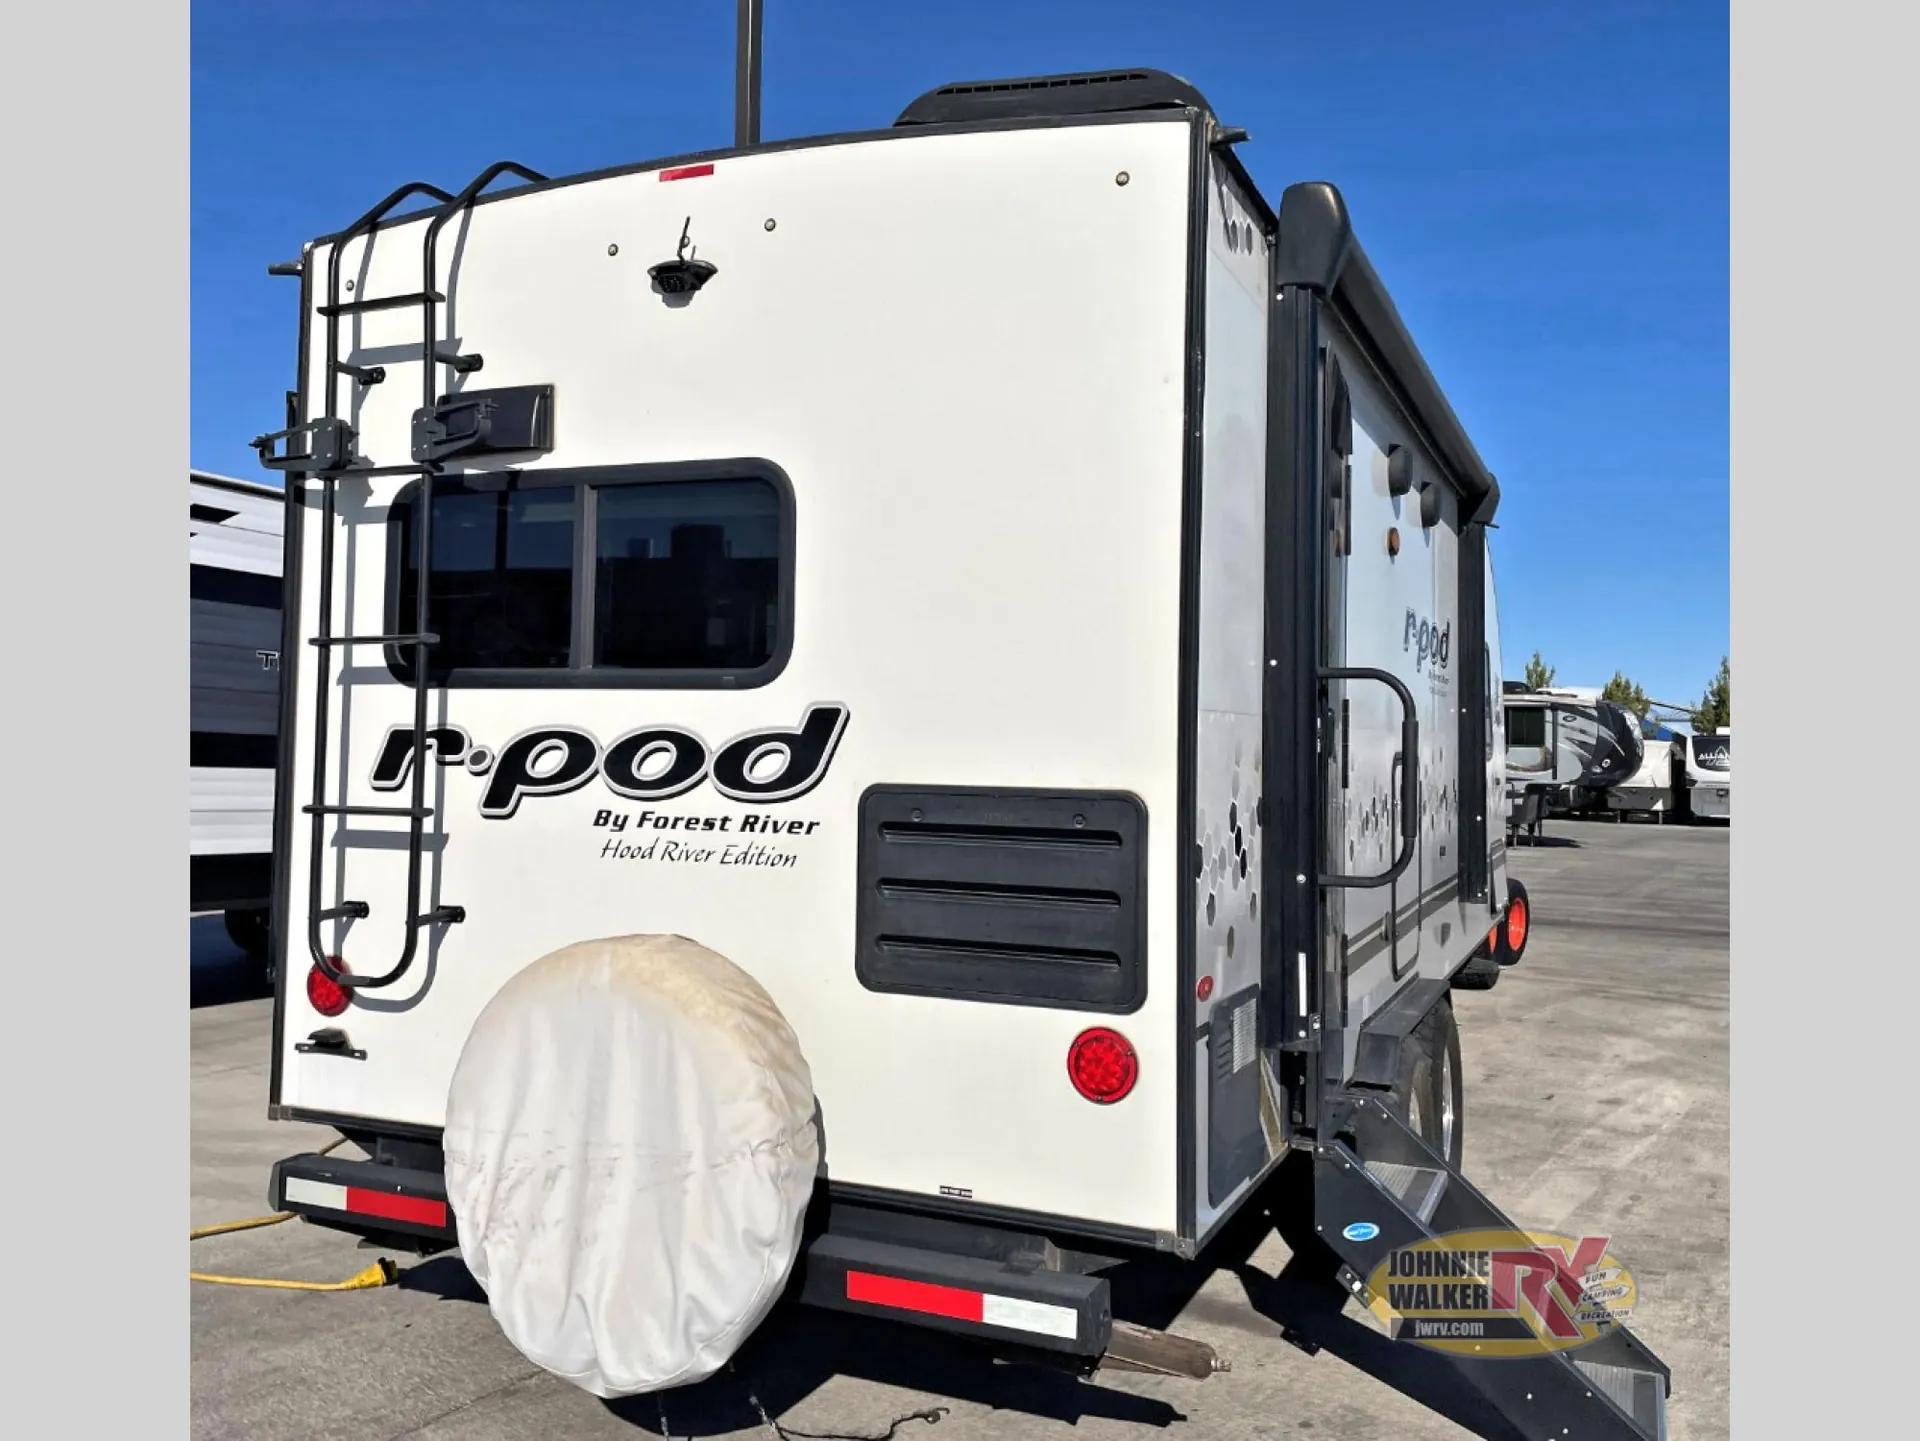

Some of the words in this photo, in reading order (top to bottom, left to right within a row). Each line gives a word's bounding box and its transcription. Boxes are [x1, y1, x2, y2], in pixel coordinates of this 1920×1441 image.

[593, 809, 629, 832] By
[637, 811, 732, 831] Forest
[739, 814, 820, 835] River
[600, 837, 660, 859] Hood
[661, 840, 716, 862] River
[720, 841, 798, 868] Edition
